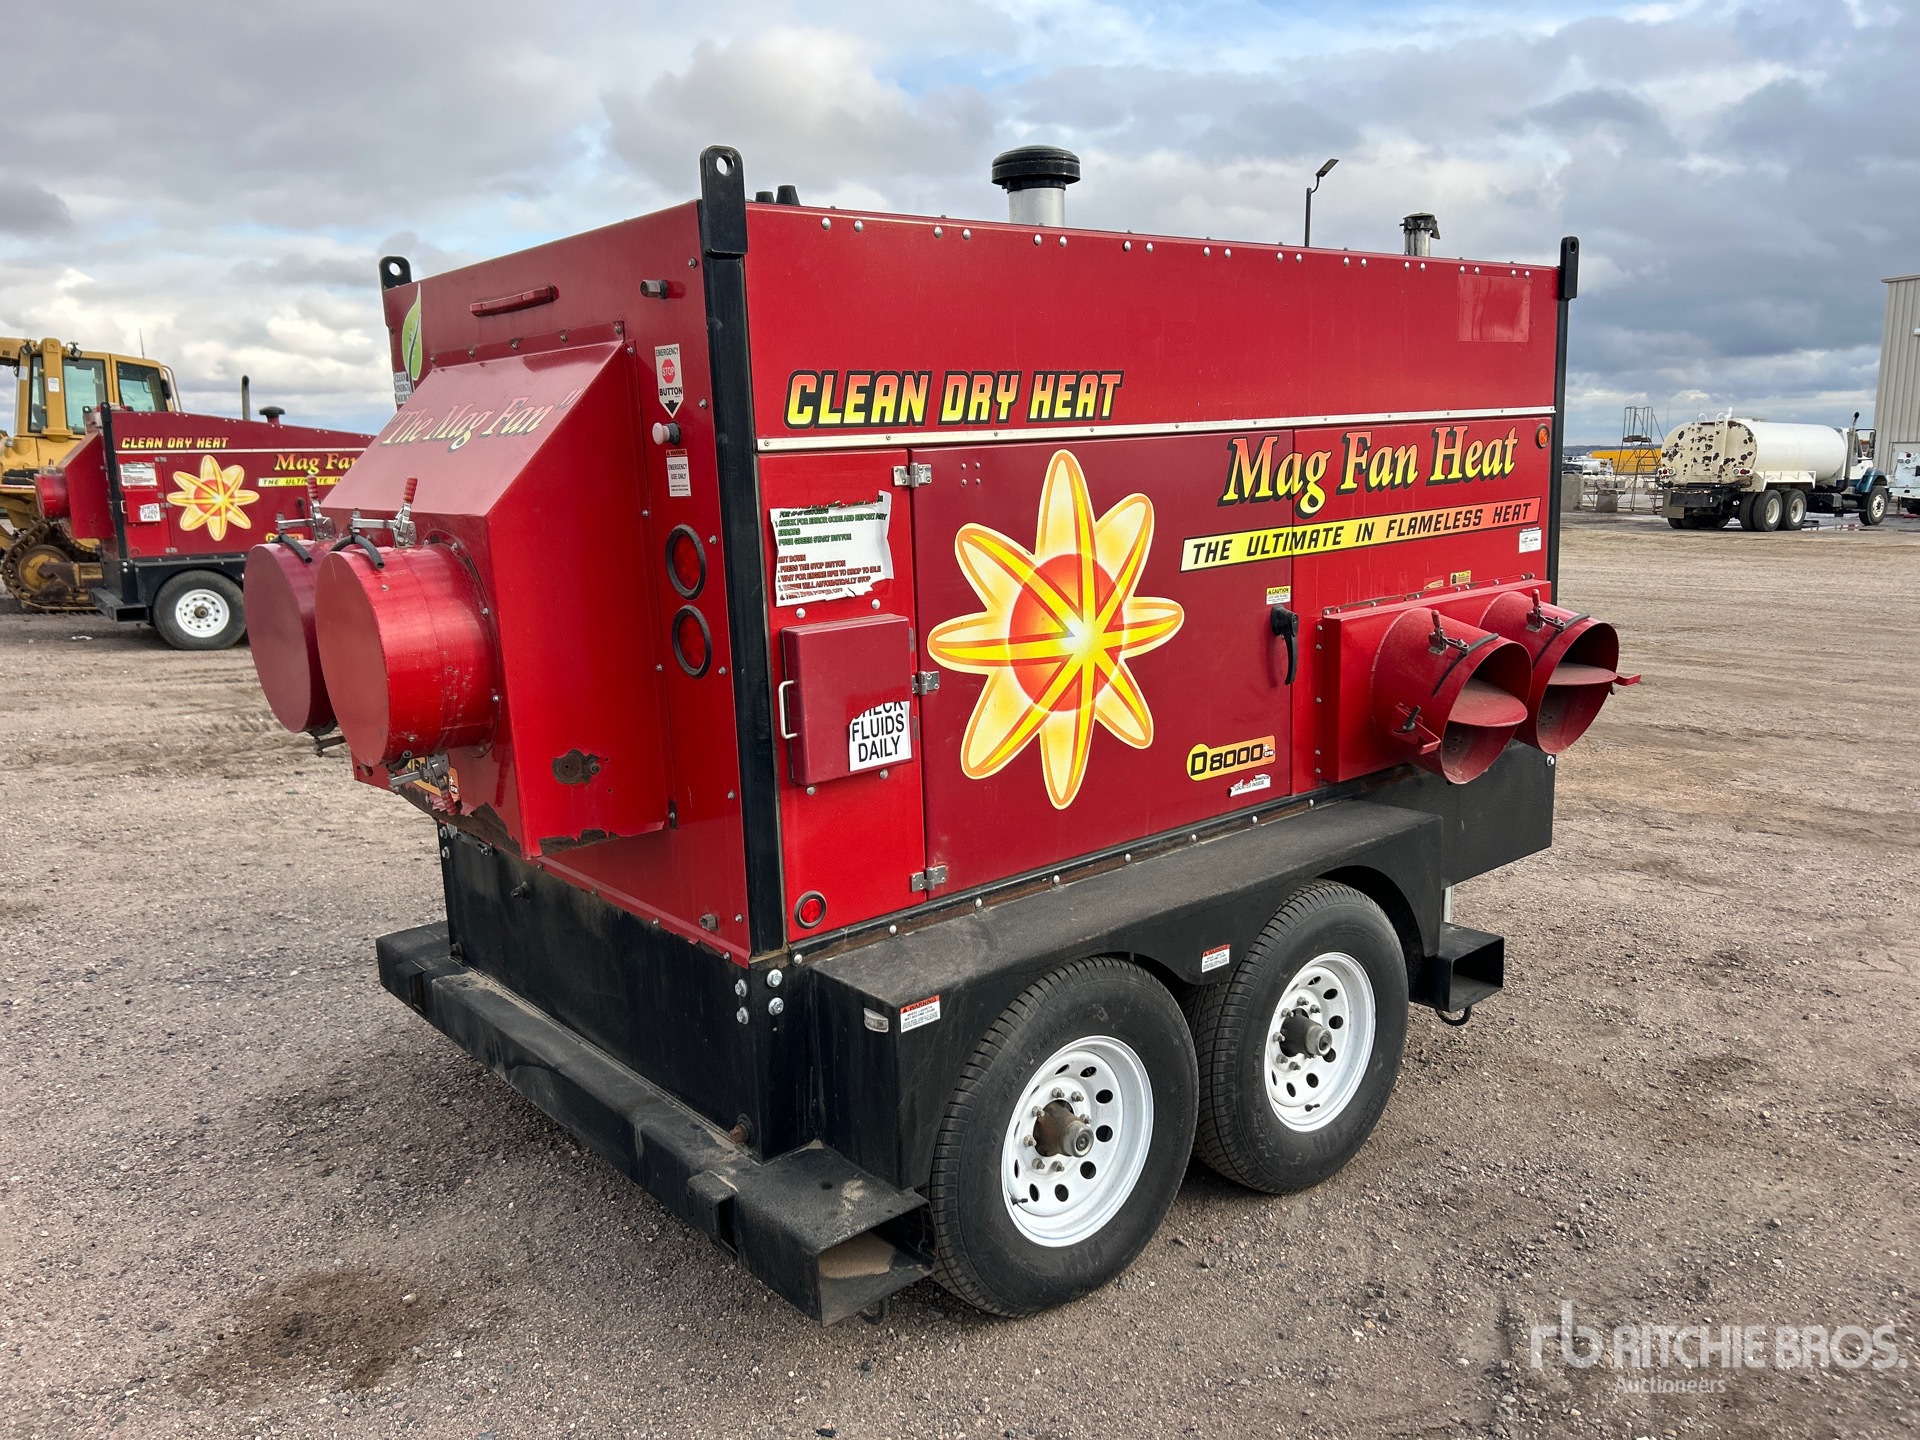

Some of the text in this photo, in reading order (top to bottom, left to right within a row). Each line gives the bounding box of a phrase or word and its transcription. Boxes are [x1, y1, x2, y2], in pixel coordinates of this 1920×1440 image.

[656, 347, 679, 357] EMERGENCY
[661, 366, 675, 377] STOP
[659, 386, 683, 397] BUTTON
[786, 371, 1123, 428] CLEAN DRY HEAT
[419, 402, 496, 453] Mag
[121, 436, 229, 449] CLEAN DRY HEAT
[273, 453, 320, 475] Mag
[668, 463, 687, 471] EMERGENCY
[1218, 425, 1519, 518] Mag Fan Heat
[797, 518, 808, 526] FOR
[809, 517, 828, 525] ERROR
[855, 513, 875, 521] REPORT
[778, 533, 852, 546] PUSH GREEN START BUTTON
[1193, 502, 1532, 565] THE ULTIMATE IN FLAMELESS HEAT
[789, 554, 806, 562] DOWN
[780, 560, 846, 573] PRESS THE STOP BUTTON
[795, 573, 806, 581] FOR
[807, 571, 826, 580] ENGINE
[870, 565, 881, 573] IDLE
[816, 577, 857, 587] AUTOMATICALLY
[857, 575, 871, 583] STOP
[852, 713, 905, 742] FLUIDS
[858, 735, 900, 763] DAILY
[909, 996, 938, 1011] WARNING
